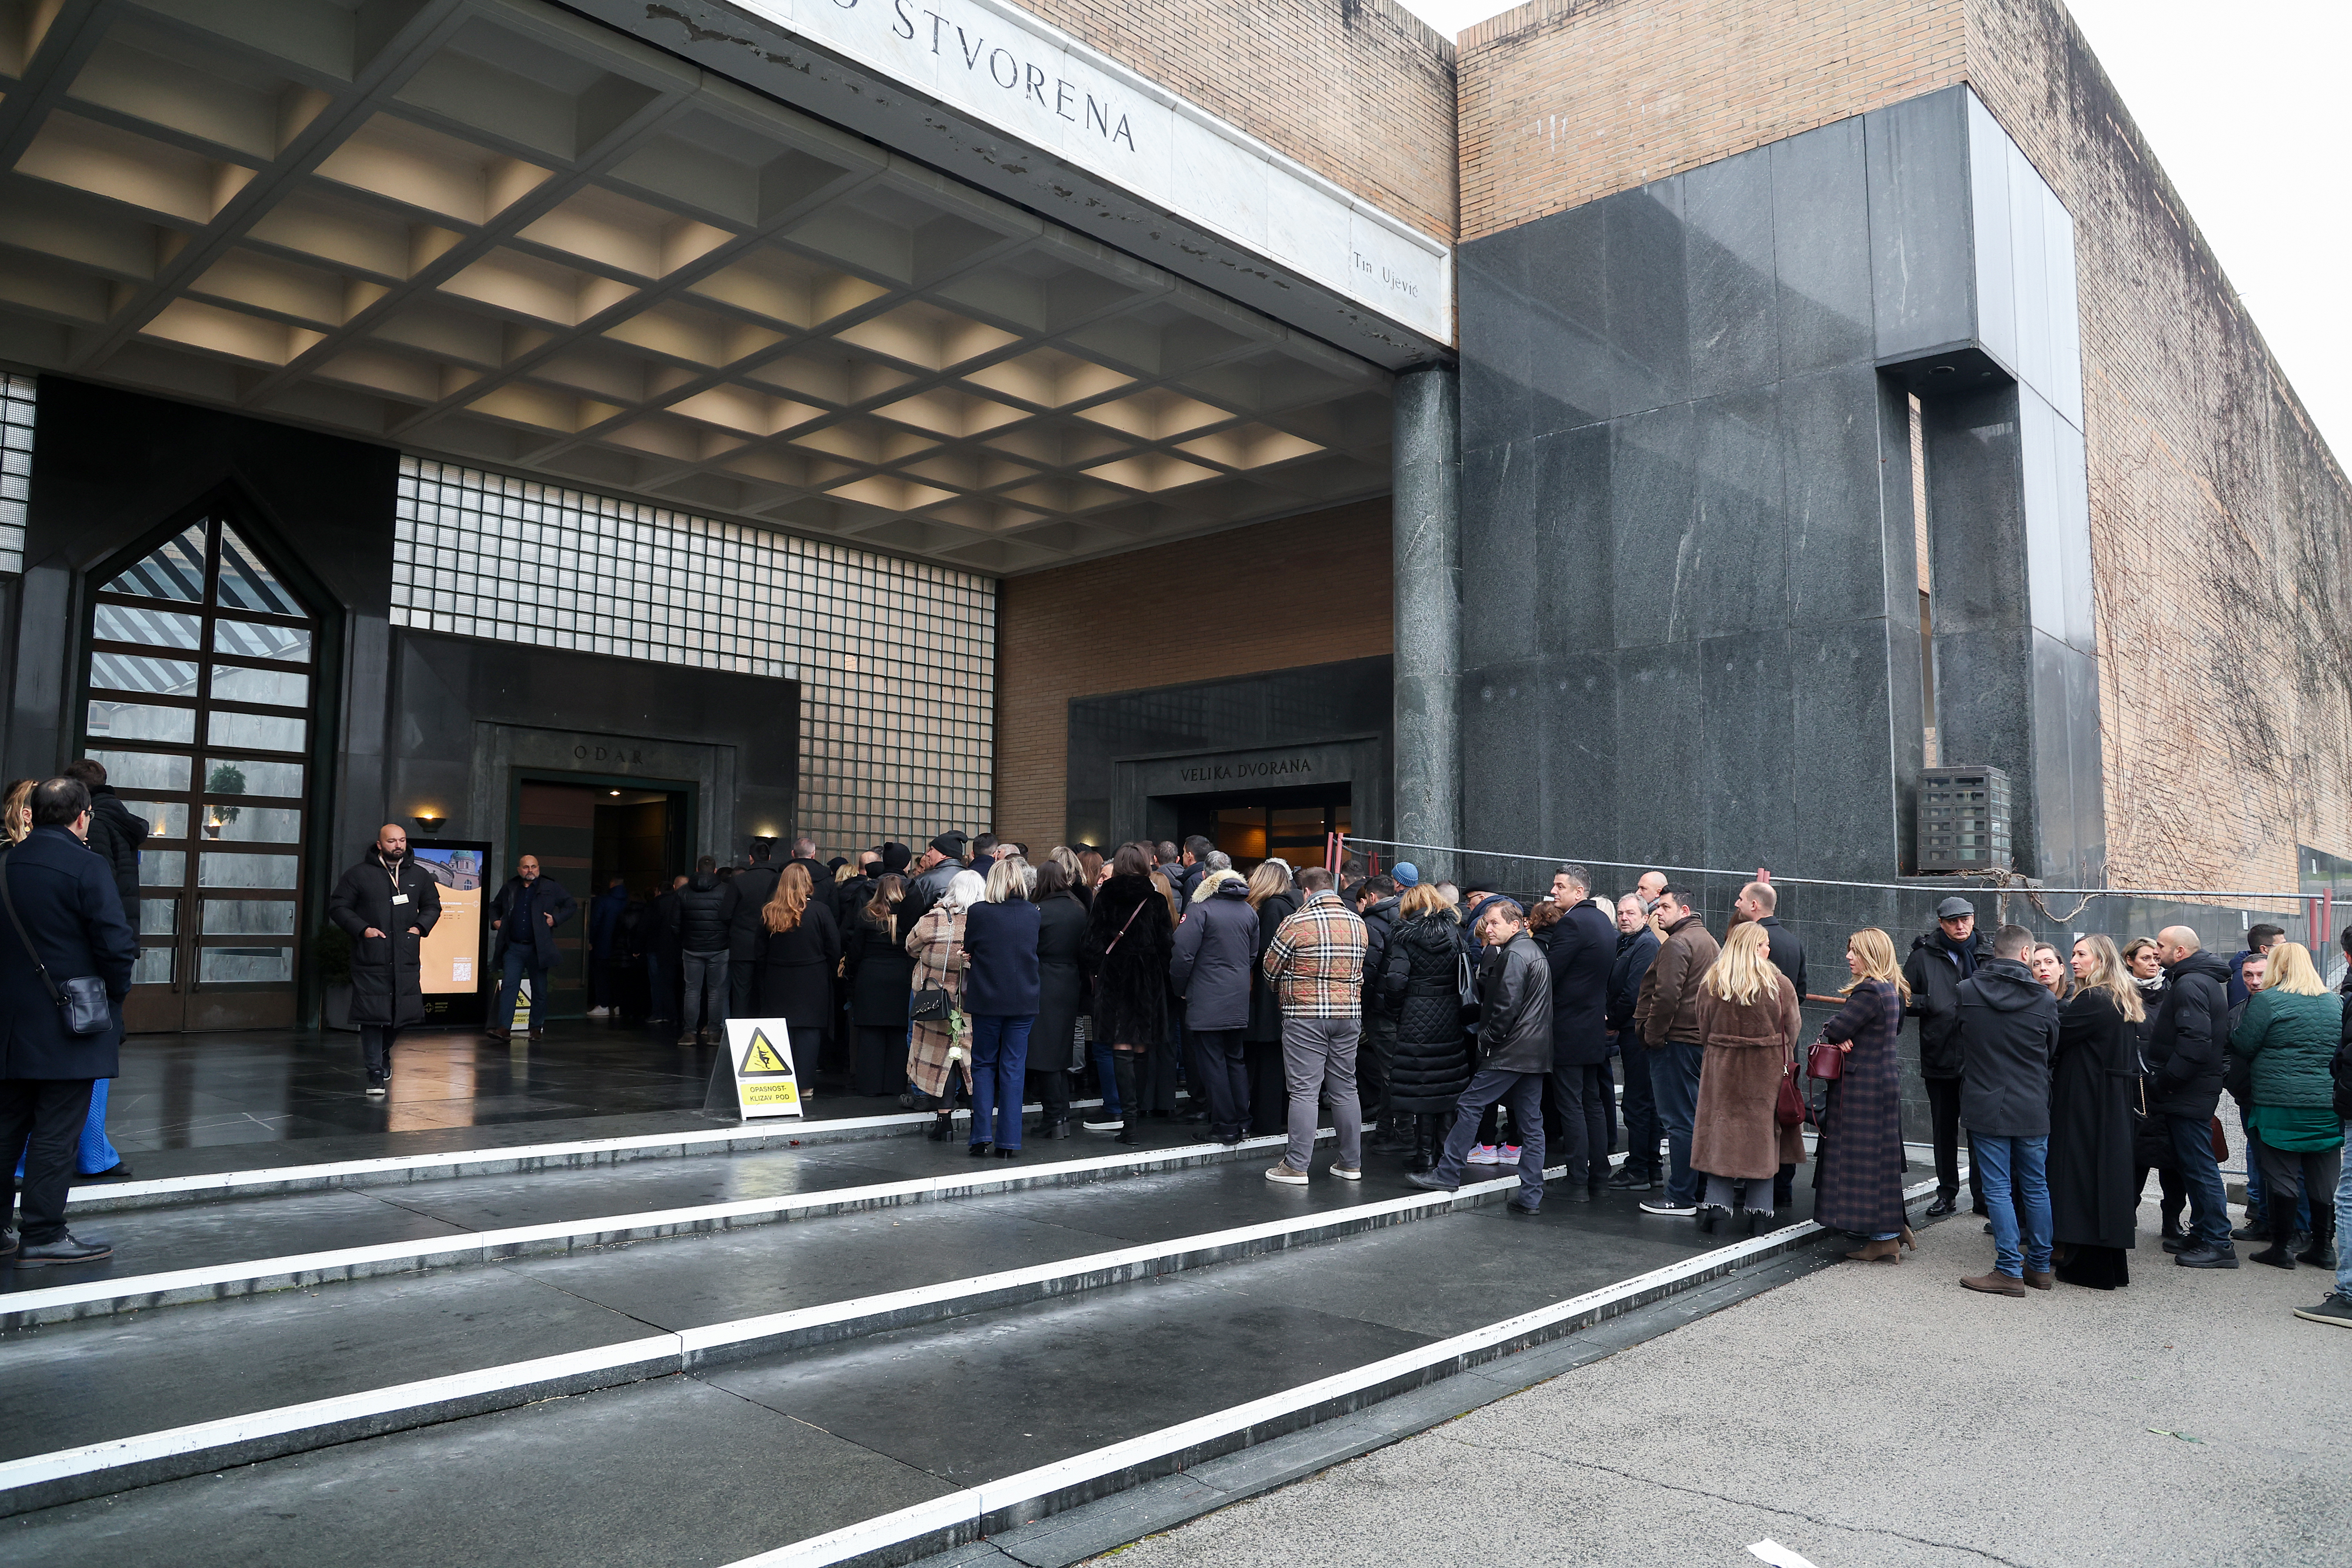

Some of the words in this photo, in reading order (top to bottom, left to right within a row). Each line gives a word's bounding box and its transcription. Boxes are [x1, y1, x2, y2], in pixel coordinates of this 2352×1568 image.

[893, 0, 1135, 152] STVORENA
[1354, 252, 1372, 273] Tin
[574, 745, 643, 764] ODAR
[1181, 766, 1232, 781] VELIKA
[1238, 758, 1311, 778] DVORANA
